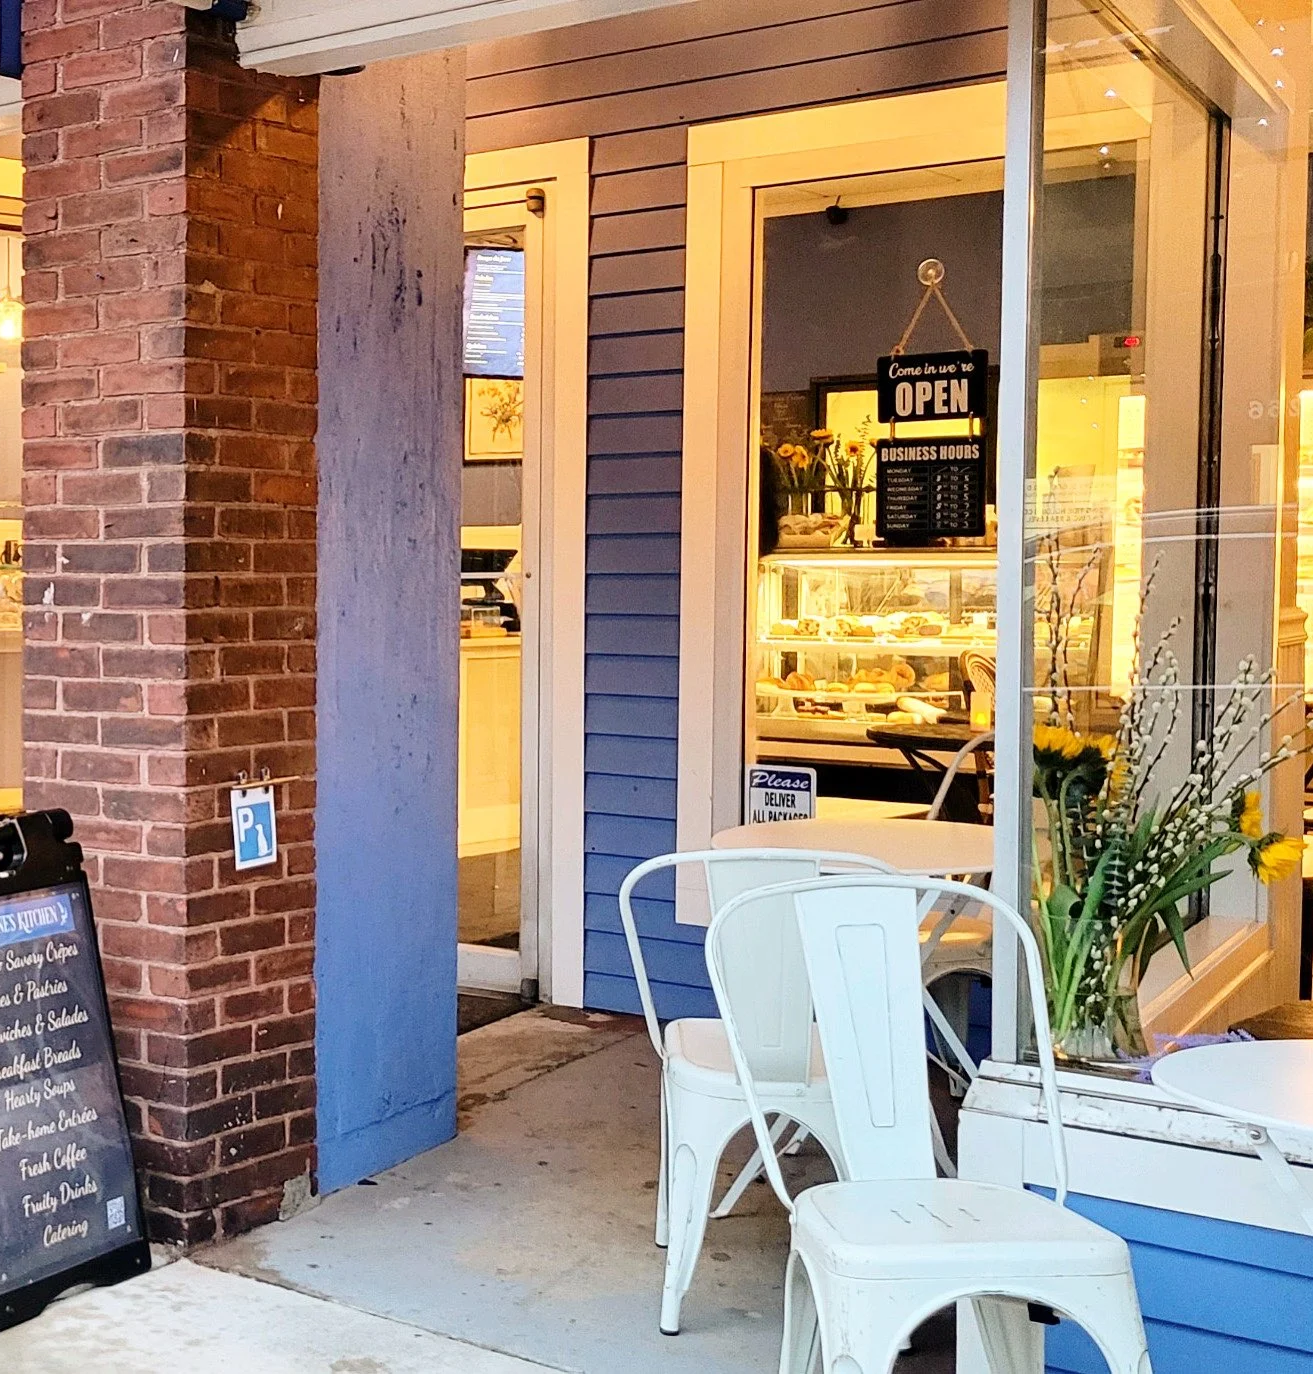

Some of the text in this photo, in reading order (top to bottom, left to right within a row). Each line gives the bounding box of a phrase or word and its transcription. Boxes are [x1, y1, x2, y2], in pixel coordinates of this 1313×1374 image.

[888, 362, 922, 379] Come
[924, 363, 936, 376] in
[895, 379, 968, 417] OPEN
[881, 444, 979, 462] BUSINESS HOURS
[751, 771, 809, 788] Please
[764, 792, 796, 808] DELIVER
[237, 807, 254, 842] P
[752, 809, 766, 824] ALL
[18, 906, 59, 934] KITCHEN
[6, 950, 44, 971] Savory
[46, 941, 79, 962] Crêpes
[14, 982, 24, 1004] &
[26, 979, 68, 1002] Pastries
[35, 1014, 46, 1034] &
[48, 1004, 89, 1032] Salades
[44, 1040, 82, 1068] Breads
[4, 1078, 76, 1112] Hearty Soups
[58, 1106, 98, 1132] Entrées
[19, 1142, 88, 1180] Fresh Coffee
[22, 1174, 98, 1218] Fruity Drinks
[43, 1220, 88, 1248] Catering
